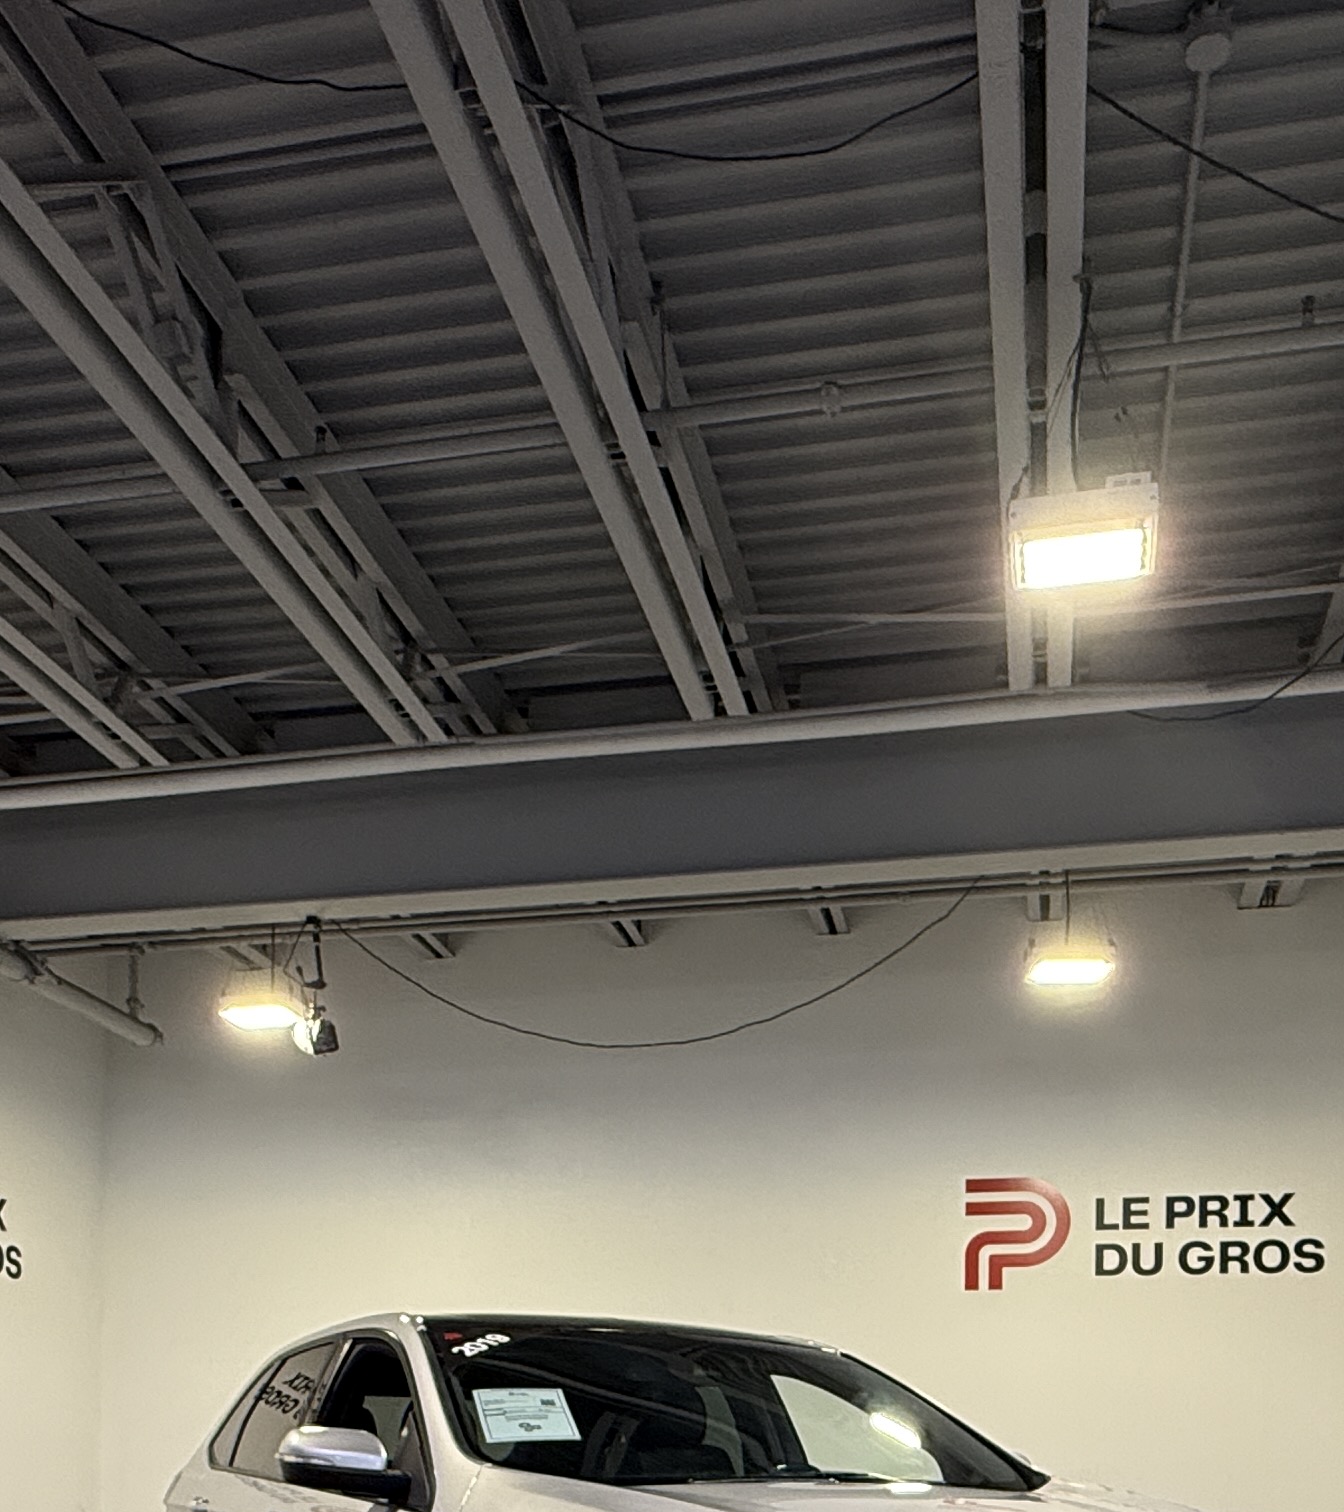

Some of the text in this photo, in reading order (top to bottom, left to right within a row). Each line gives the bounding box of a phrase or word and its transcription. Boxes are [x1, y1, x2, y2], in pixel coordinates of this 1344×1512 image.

[1095, 1192, 1296, 1230] LE PRIX
[1095, 1238, 1325, 1276] DU GROS
